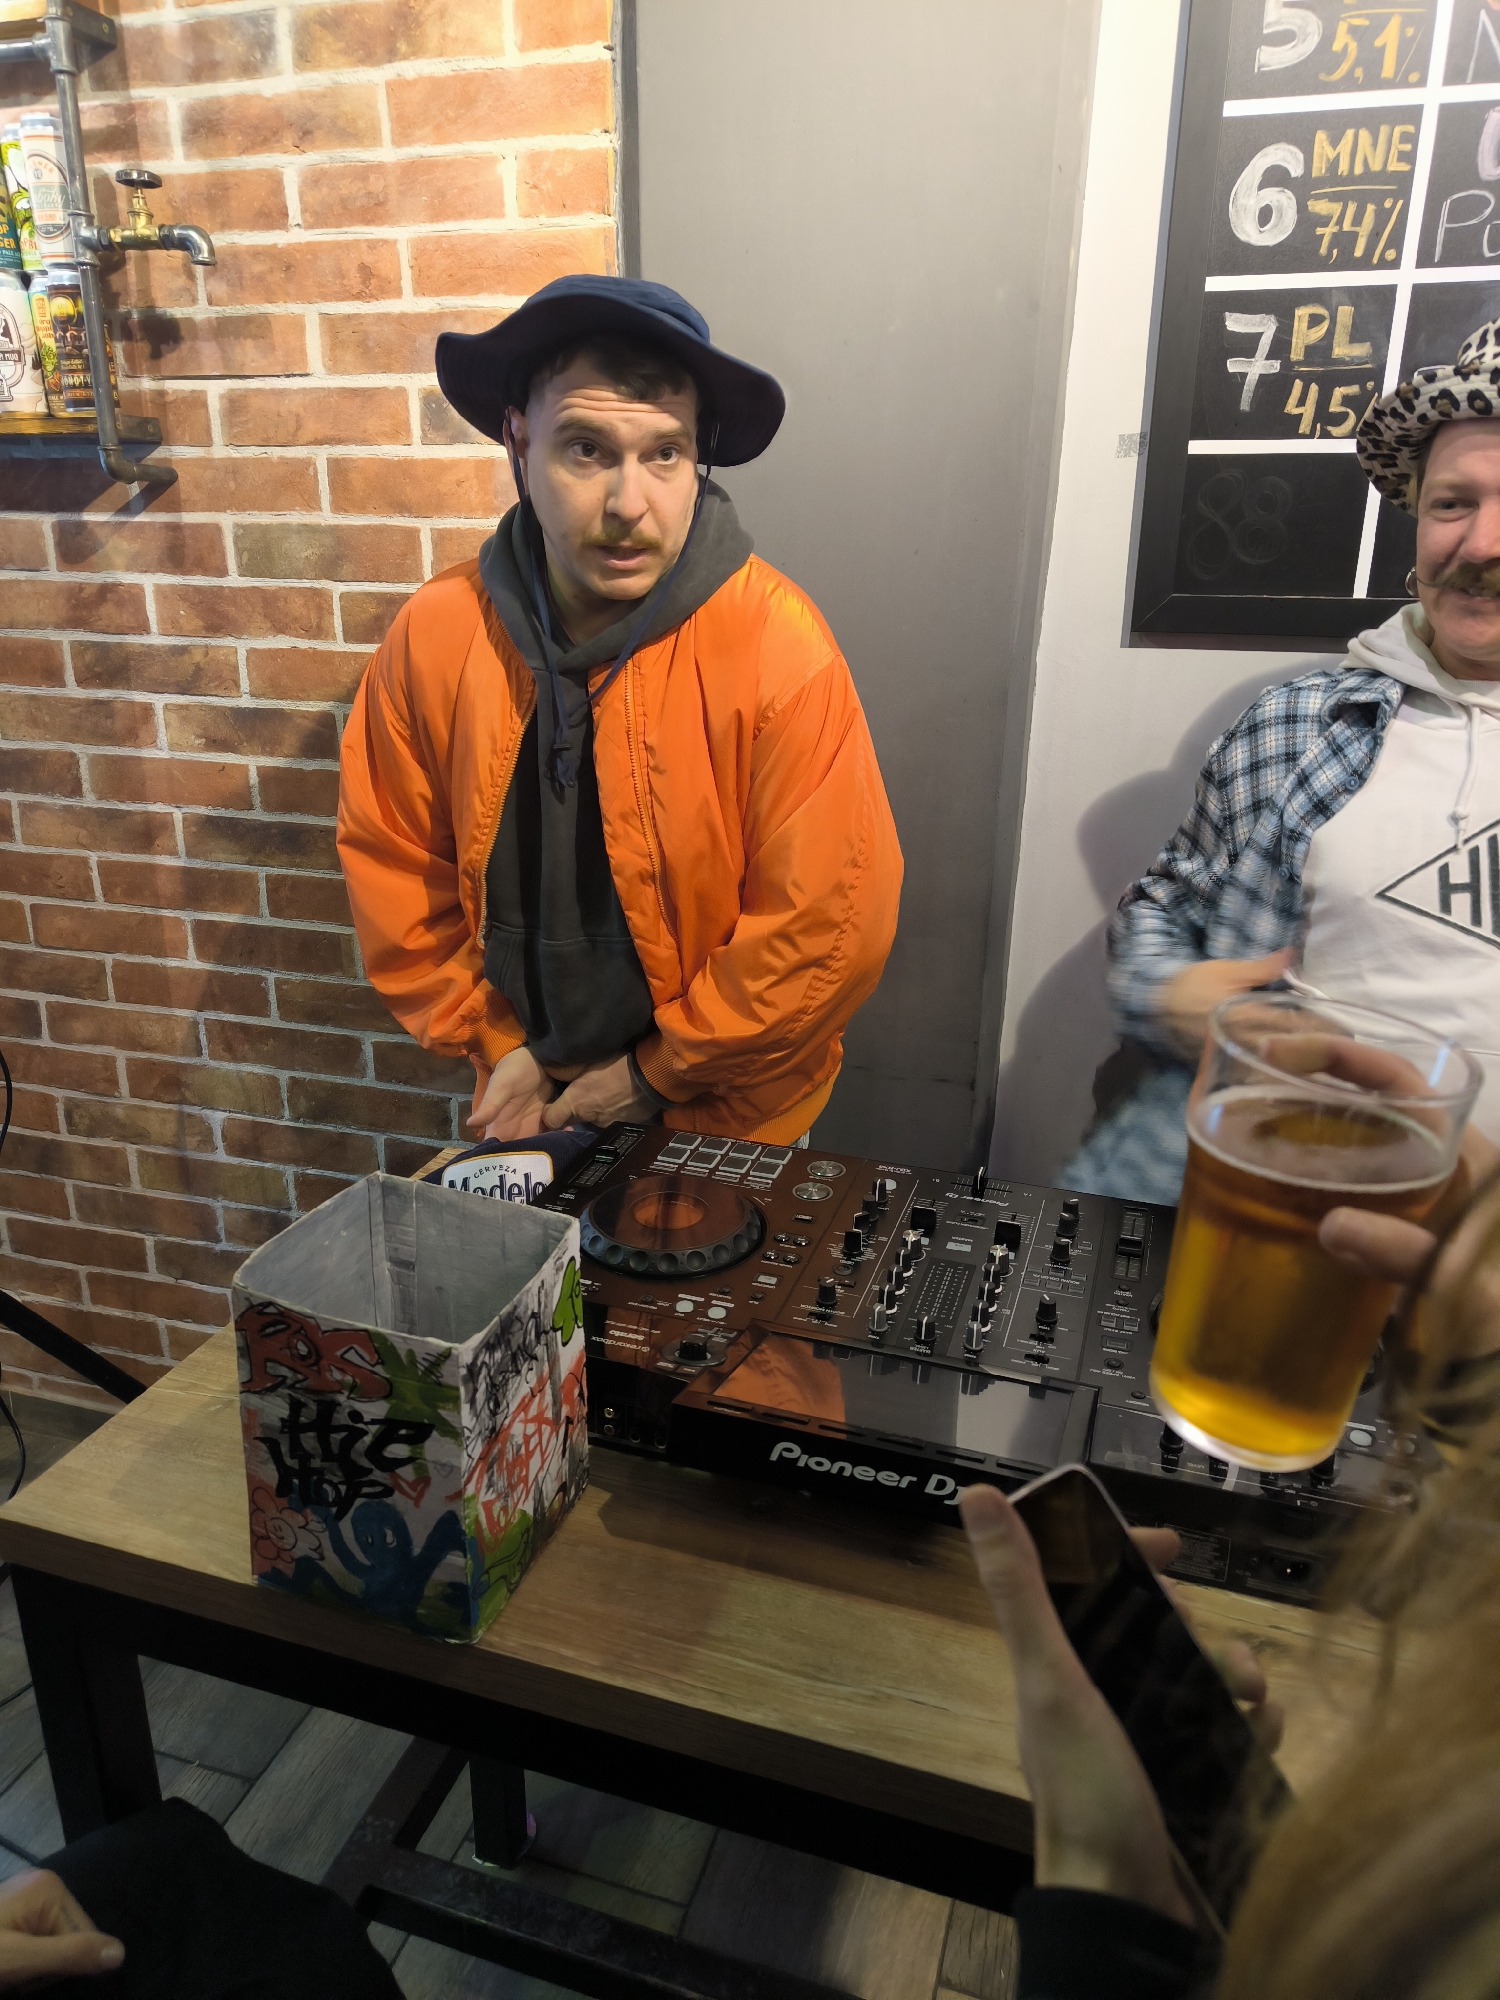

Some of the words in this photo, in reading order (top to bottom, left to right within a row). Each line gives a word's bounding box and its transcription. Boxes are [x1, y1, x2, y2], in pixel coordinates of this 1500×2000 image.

[1254, 0, 1322, 73] 5
[1312, 124, 1415, 178] MNE
[1229, 143, 1304, 246] 6
[1308, 197, 1403, 263] 7,4%
[1223, 311, 1281, 413] 7
[1290, 304, 1372, 362] PL
[474, 1165, 517, 1178] CERVEZA
[591, 1335, 642, 1350] rekordbox
[769, 1442, 917, 1488] Pioneer
